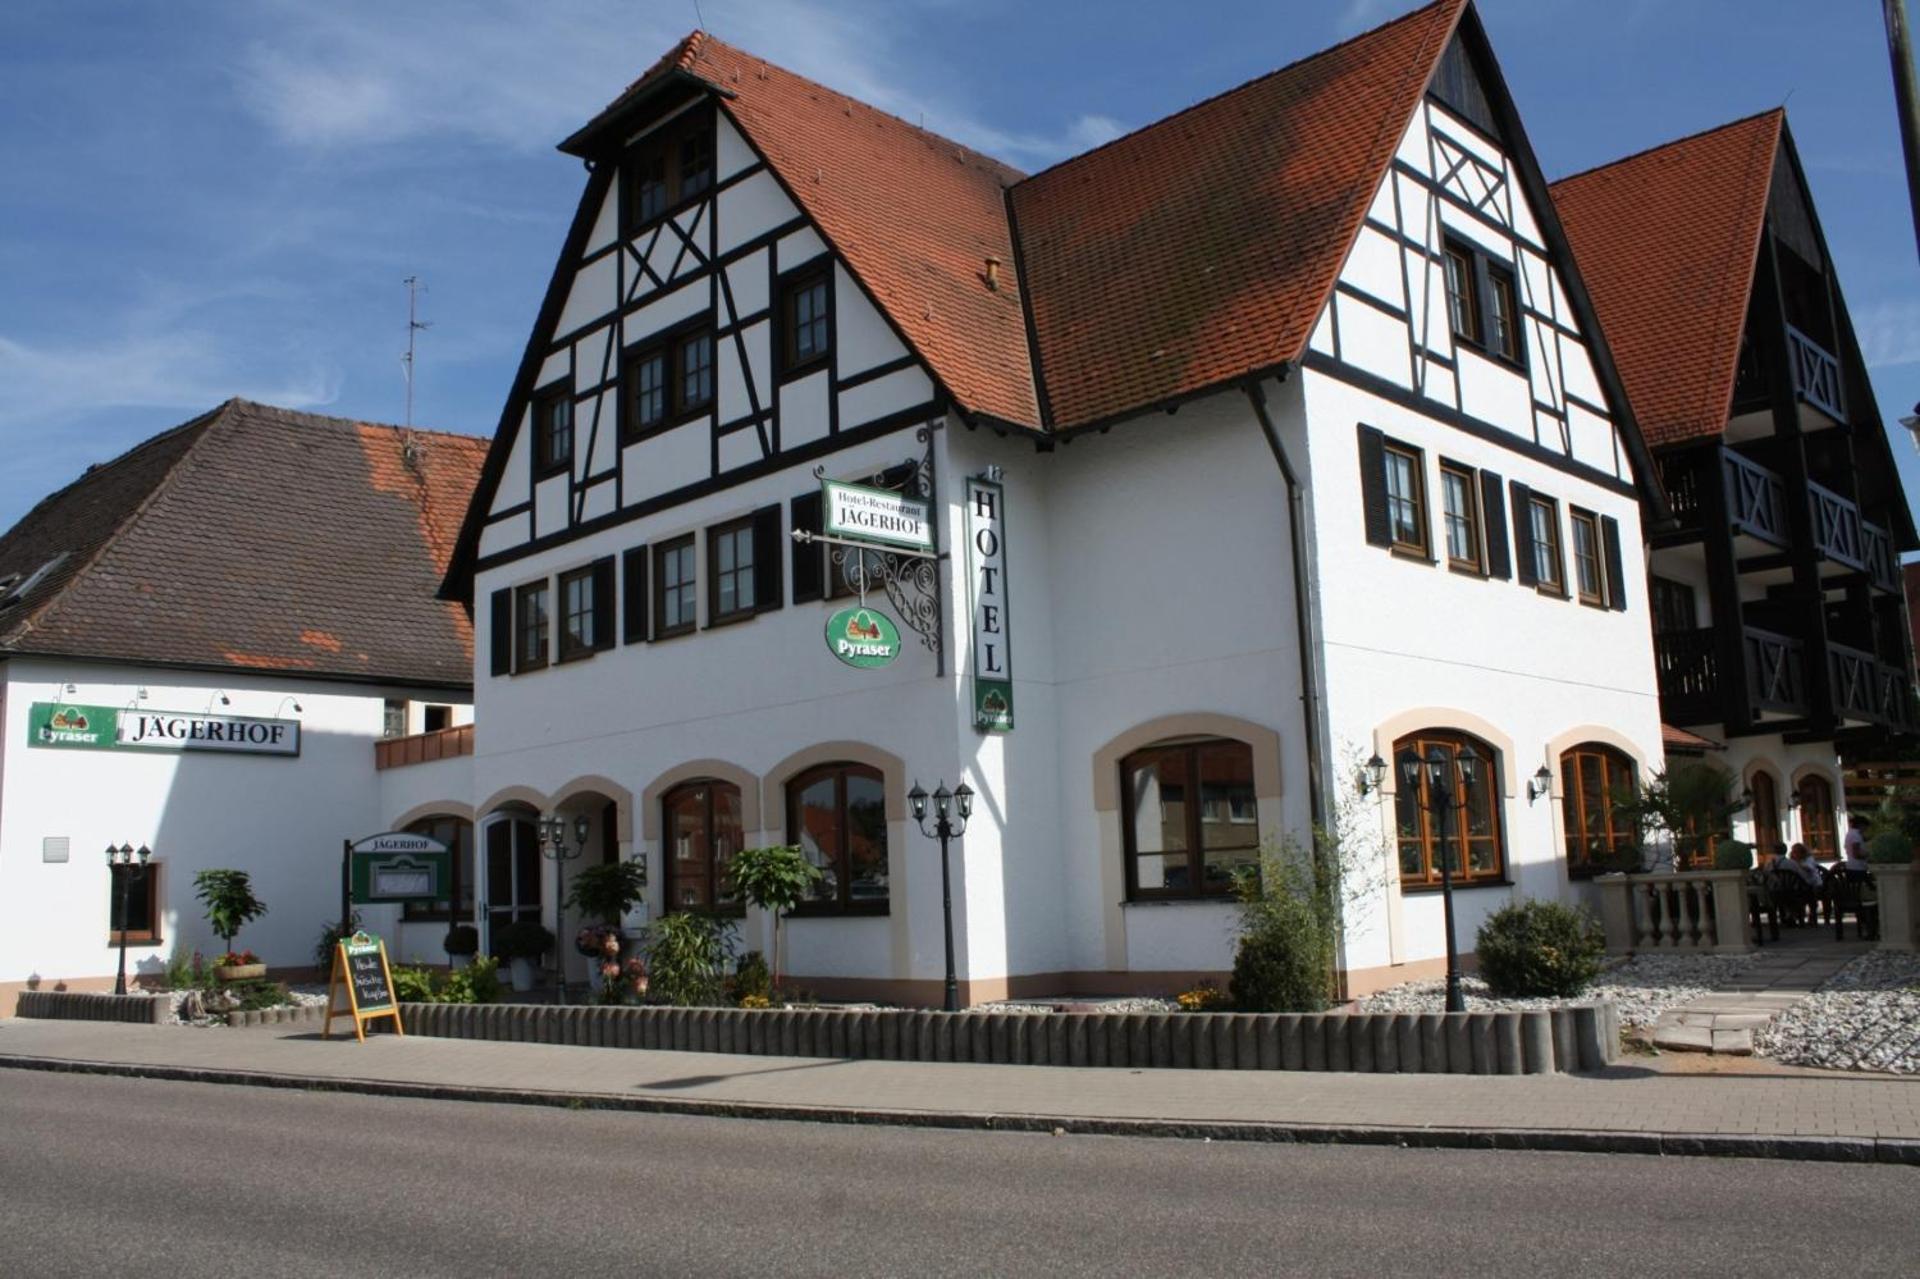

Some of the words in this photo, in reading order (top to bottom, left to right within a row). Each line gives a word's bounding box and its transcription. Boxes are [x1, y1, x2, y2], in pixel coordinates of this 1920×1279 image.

[838, 491, 921, 517] Hotel-Restaurant
[837, 504, 923, 535] JÄGERHOF
[974, 489, 1002, 673] HOTEL
[837, 639, 891, 657] Pyraser
[39, 727, 99, 744] Pyraser
[132, 715, 285, 745] JÄGERHOF
